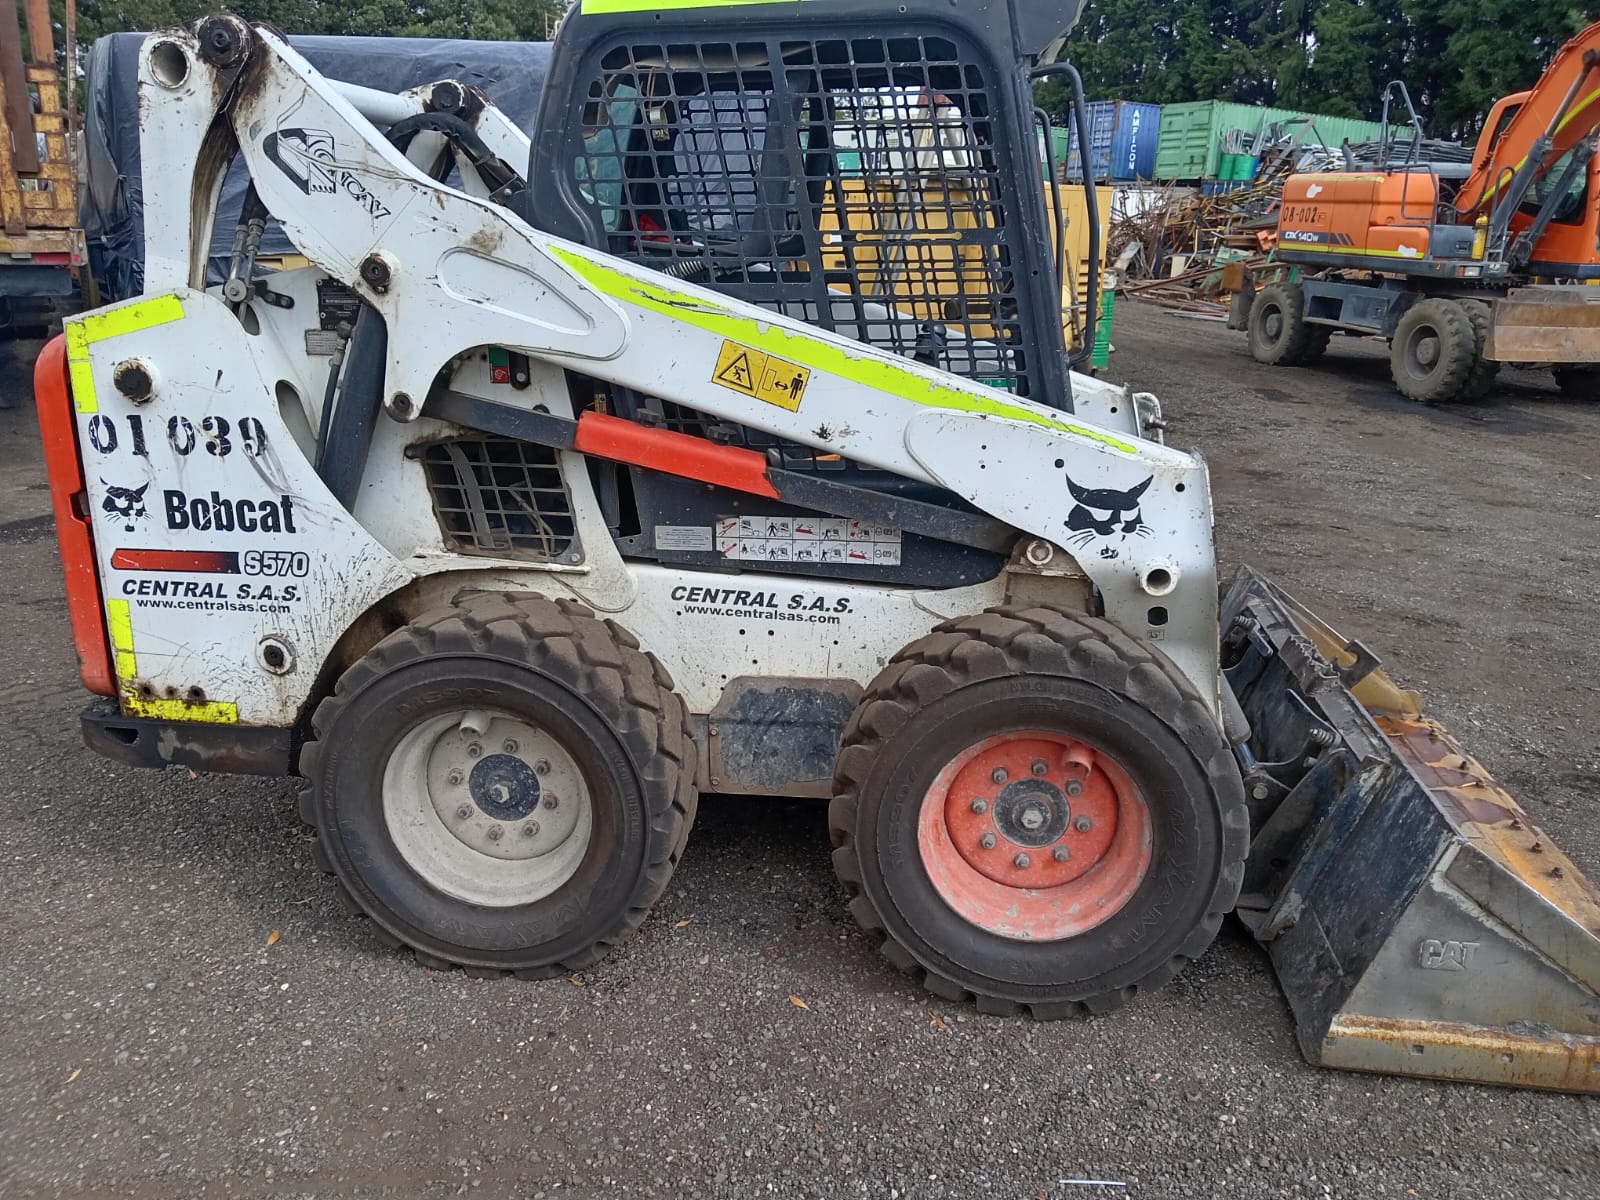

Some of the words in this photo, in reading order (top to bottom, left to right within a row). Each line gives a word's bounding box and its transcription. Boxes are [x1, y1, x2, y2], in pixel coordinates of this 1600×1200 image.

[163, 489, 296, 534] Bobcat
[243, 550, 310, 578] S570
[122, 578, 228, 600] CENTRAL
[236, 583, 302, 603] S.A.S.
[670, 585, 780, 609] CENTRAL
[786, 593, 854, 614] S.A.S.
[136, 598, 291, 615] www.centralsas.com
[684, 604, 840, 625] www.centralsas.com
[1419, 938, 1480, 971] CAT
